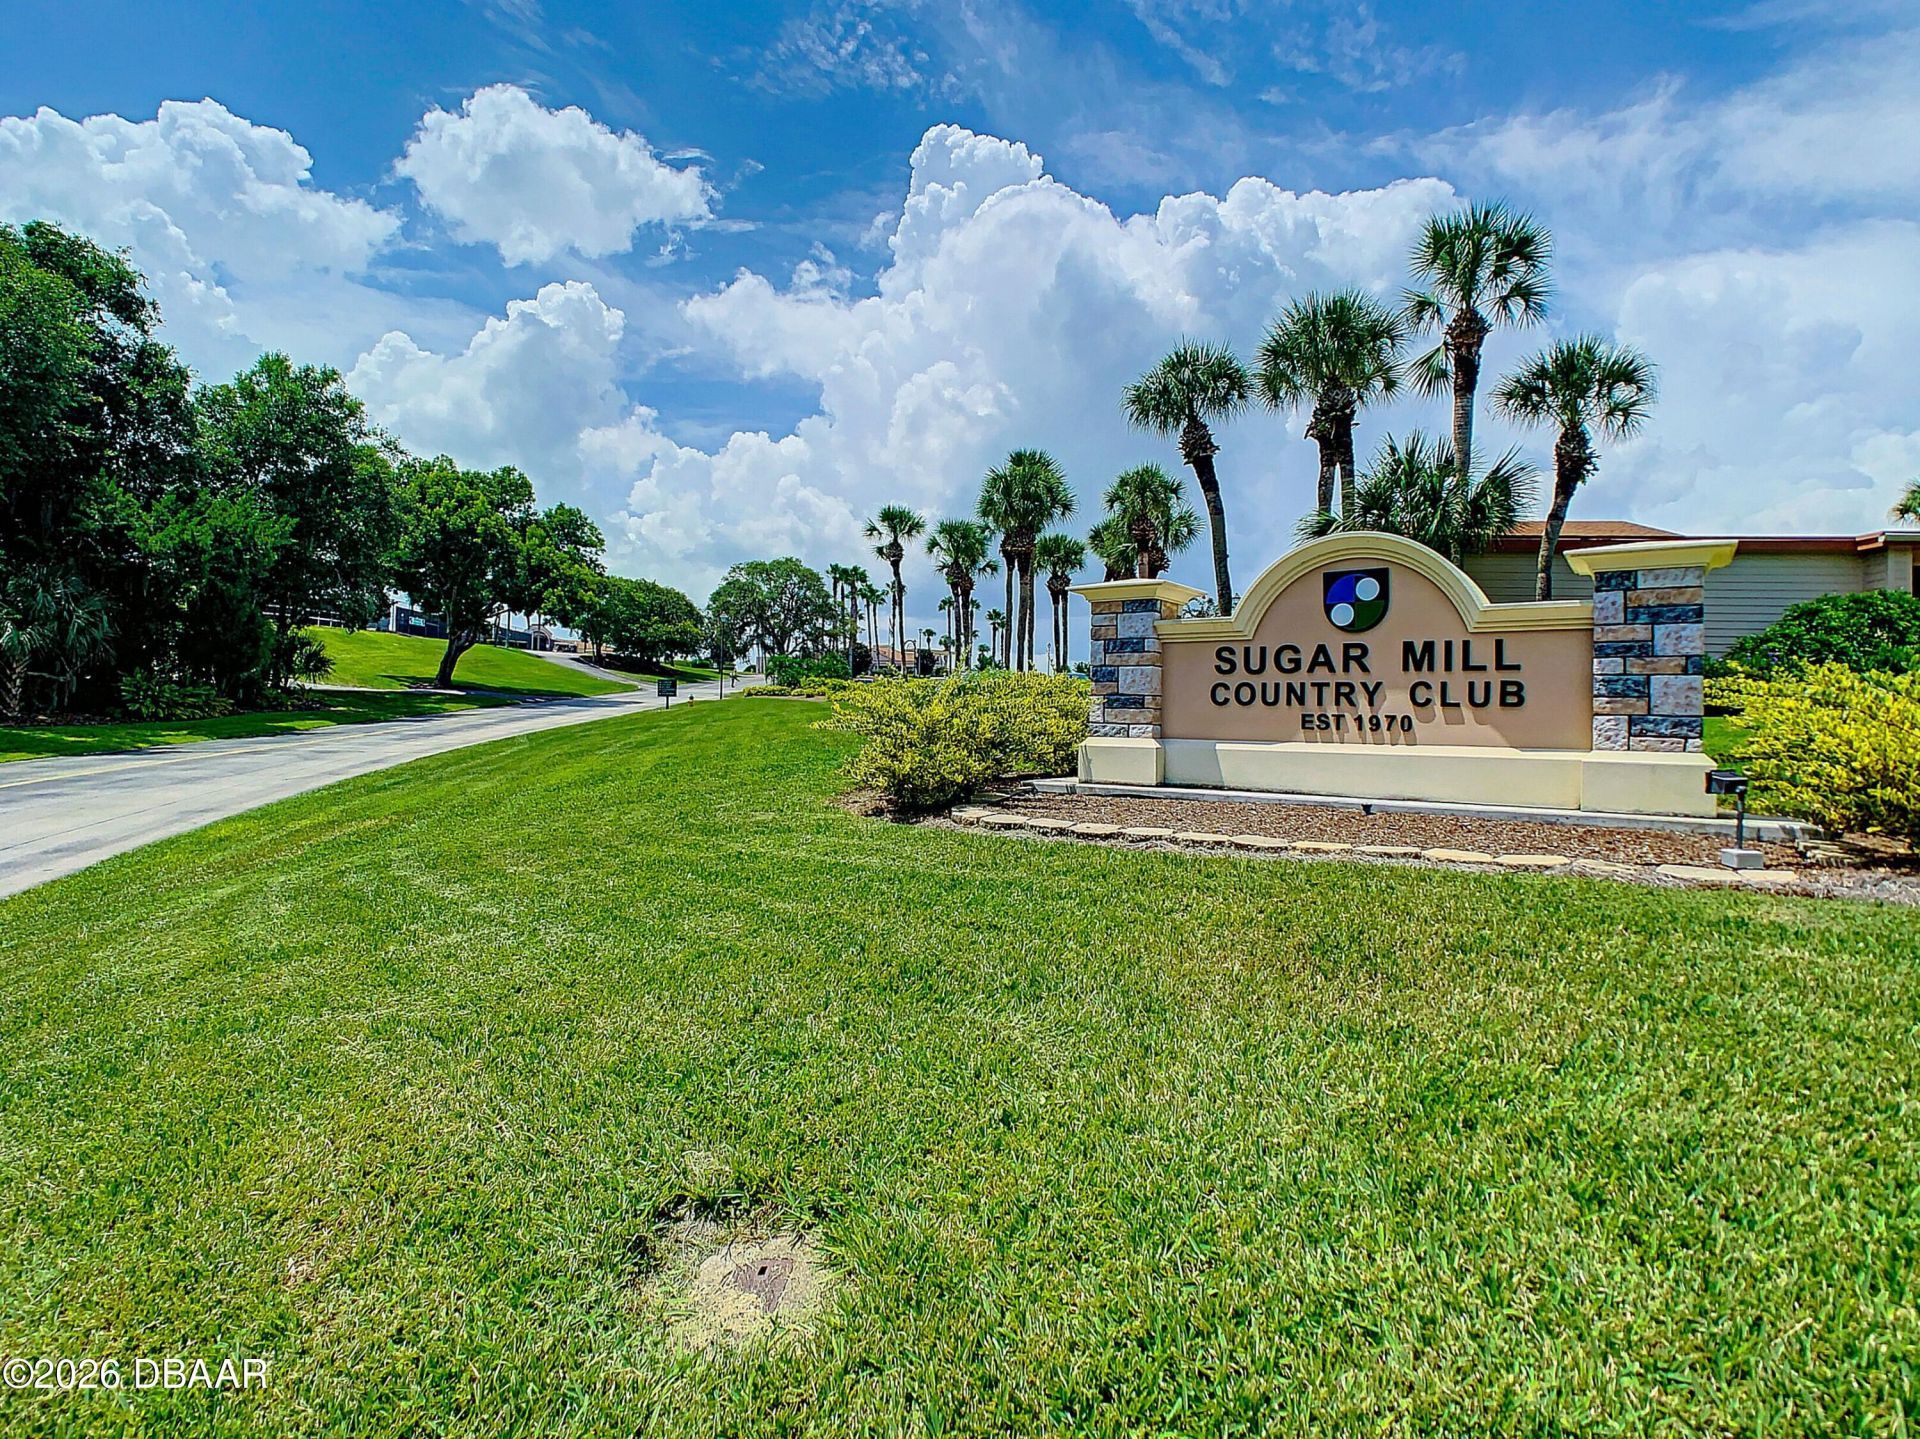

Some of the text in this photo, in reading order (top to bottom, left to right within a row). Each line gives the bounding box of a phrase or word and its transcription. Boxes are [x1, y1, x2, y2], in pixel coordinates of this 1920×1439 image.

[1214, 639, 1521, 675] SUGAR MILL
[1210, 680, 1525, 708] COUNTRY CLUB
[1301, 714, 1413, 732] EST 1970
